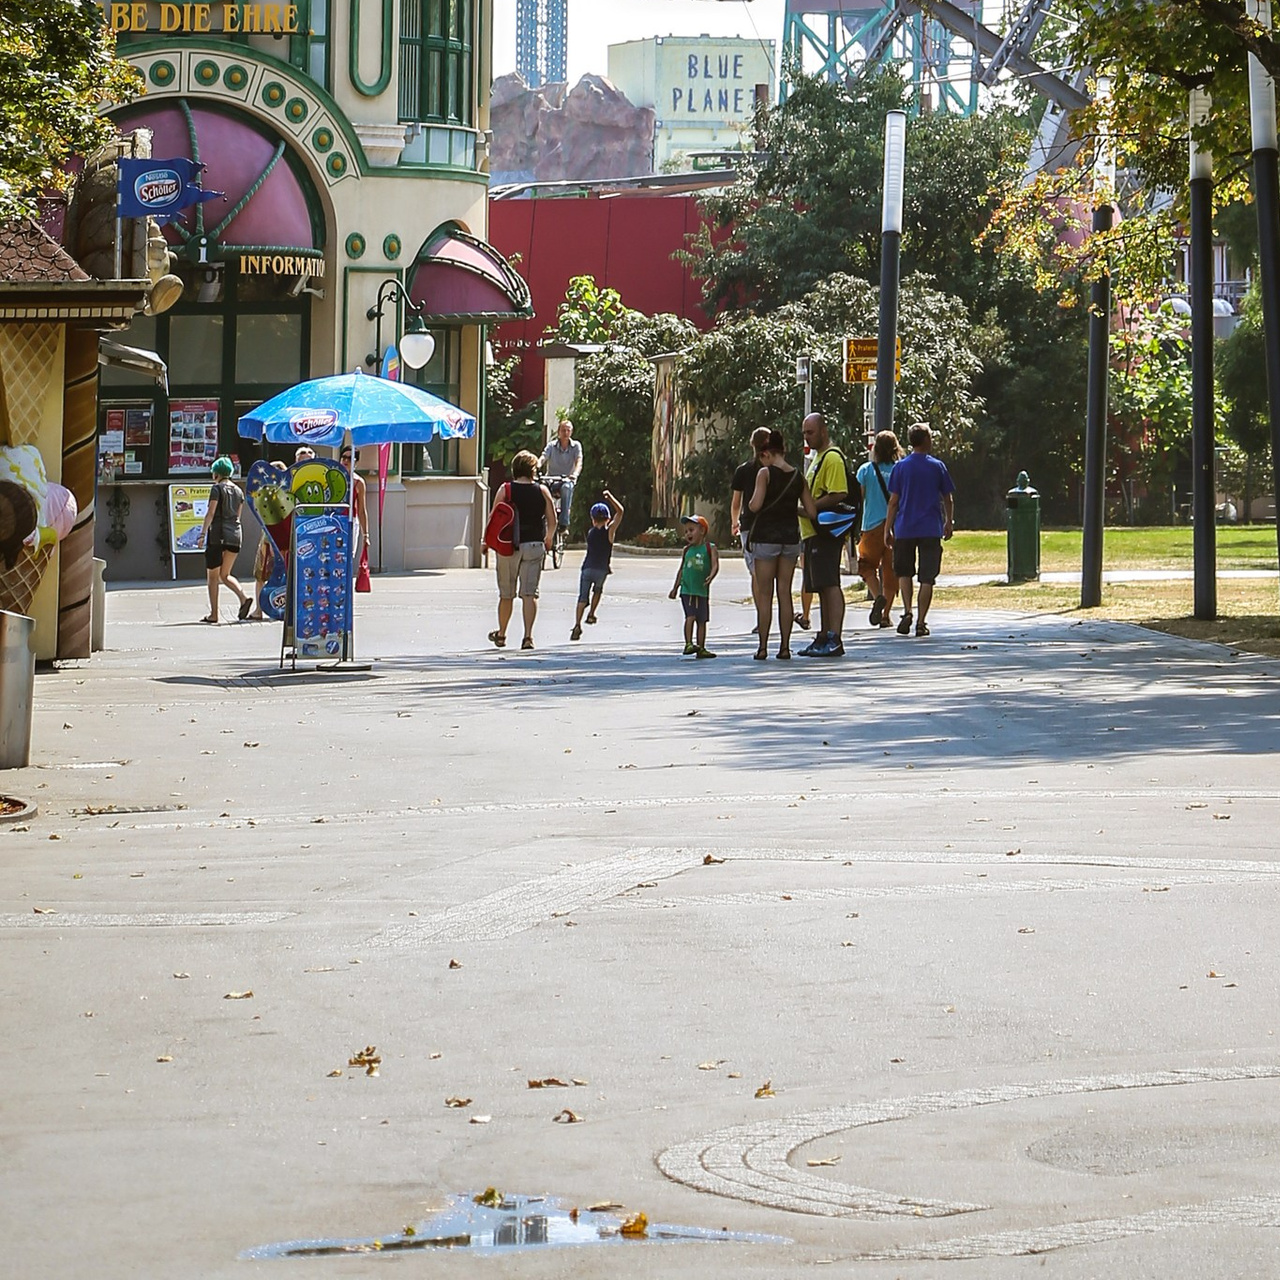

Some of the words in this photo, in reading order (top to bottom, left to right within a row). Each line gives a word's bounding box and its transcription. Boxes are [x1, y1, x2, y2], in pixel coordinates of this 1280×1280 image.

[160, 3, 211, 32] DIE
[223, 4, 299, 33] EHRE
[688, 54, 744, 79] BLUE
[240, 255, 325, 278] INFORMATIO
